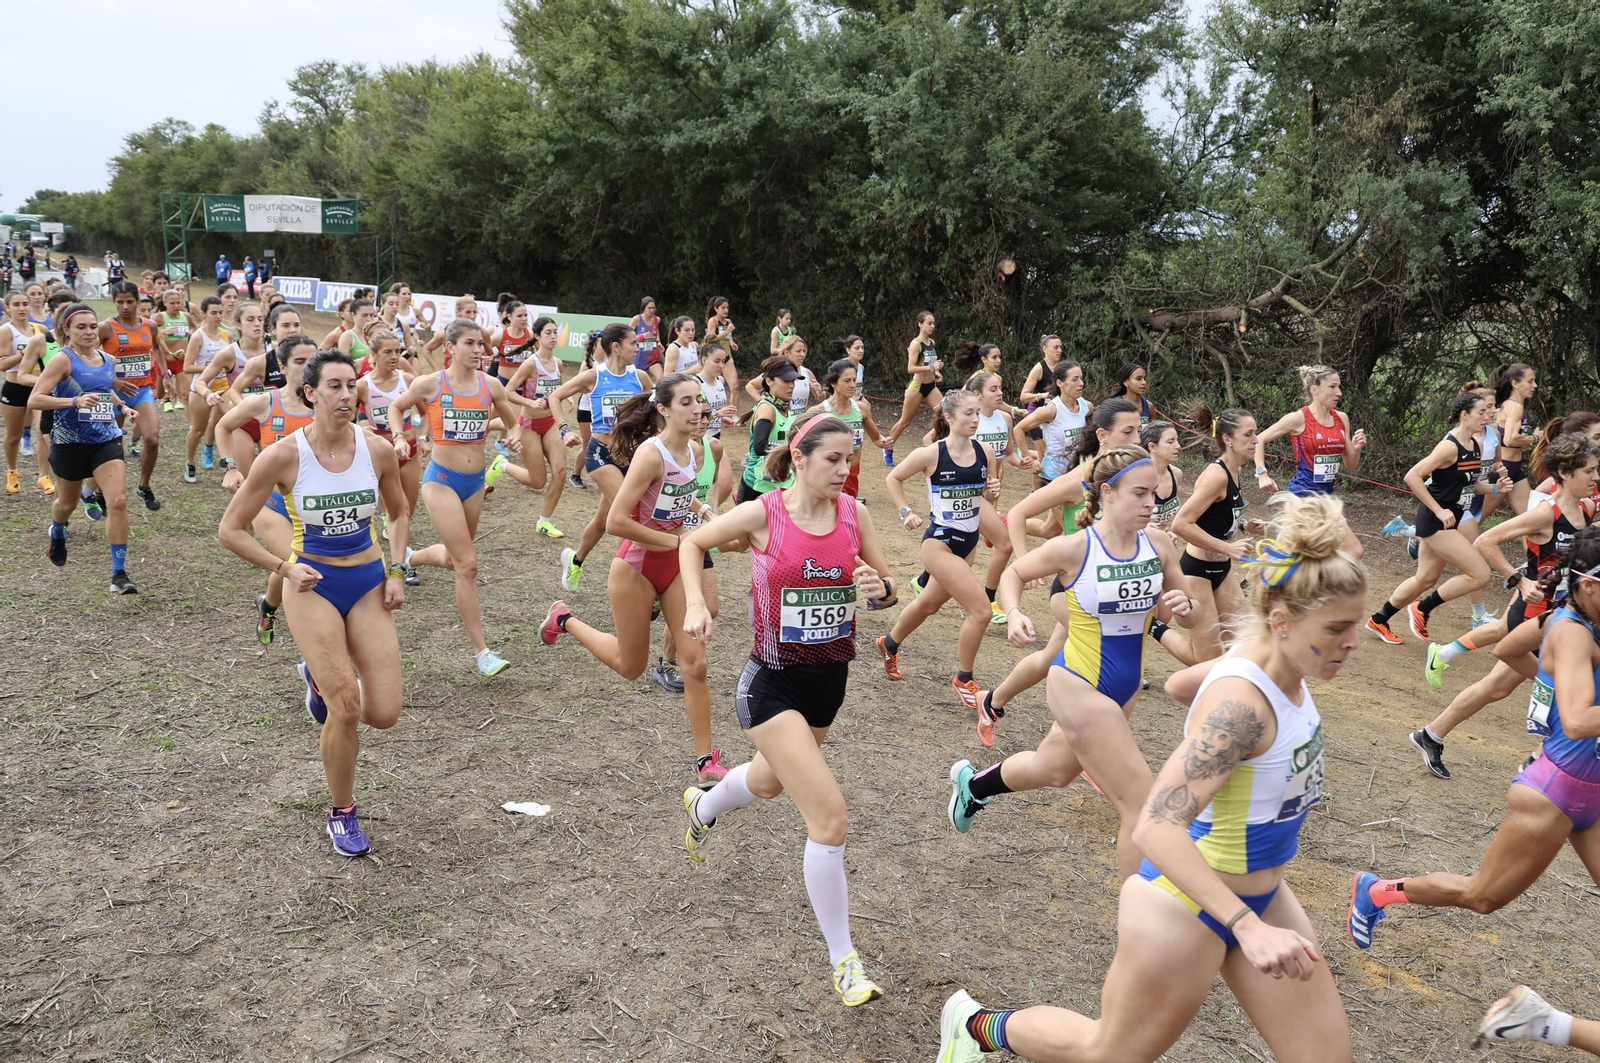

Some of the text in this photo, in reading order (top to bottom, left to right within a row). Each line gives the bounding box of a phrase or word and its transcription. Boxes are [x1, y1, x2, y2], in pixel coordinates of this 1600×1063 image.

[249, 203, 317, 213] DIPUTACIÓN DE
[266, 216, 302, 224] SEVILLA
[121, 363, 146, 372] 1708
[452, 420, 484, 432] 1707
[671, 494, 692, 510] 529
[952, 499, 973, 511] 684
[322, 508, 359, 526] 634
[1118, 578, 1153, 600] 632
[797, 606, 847, 627] 1569
